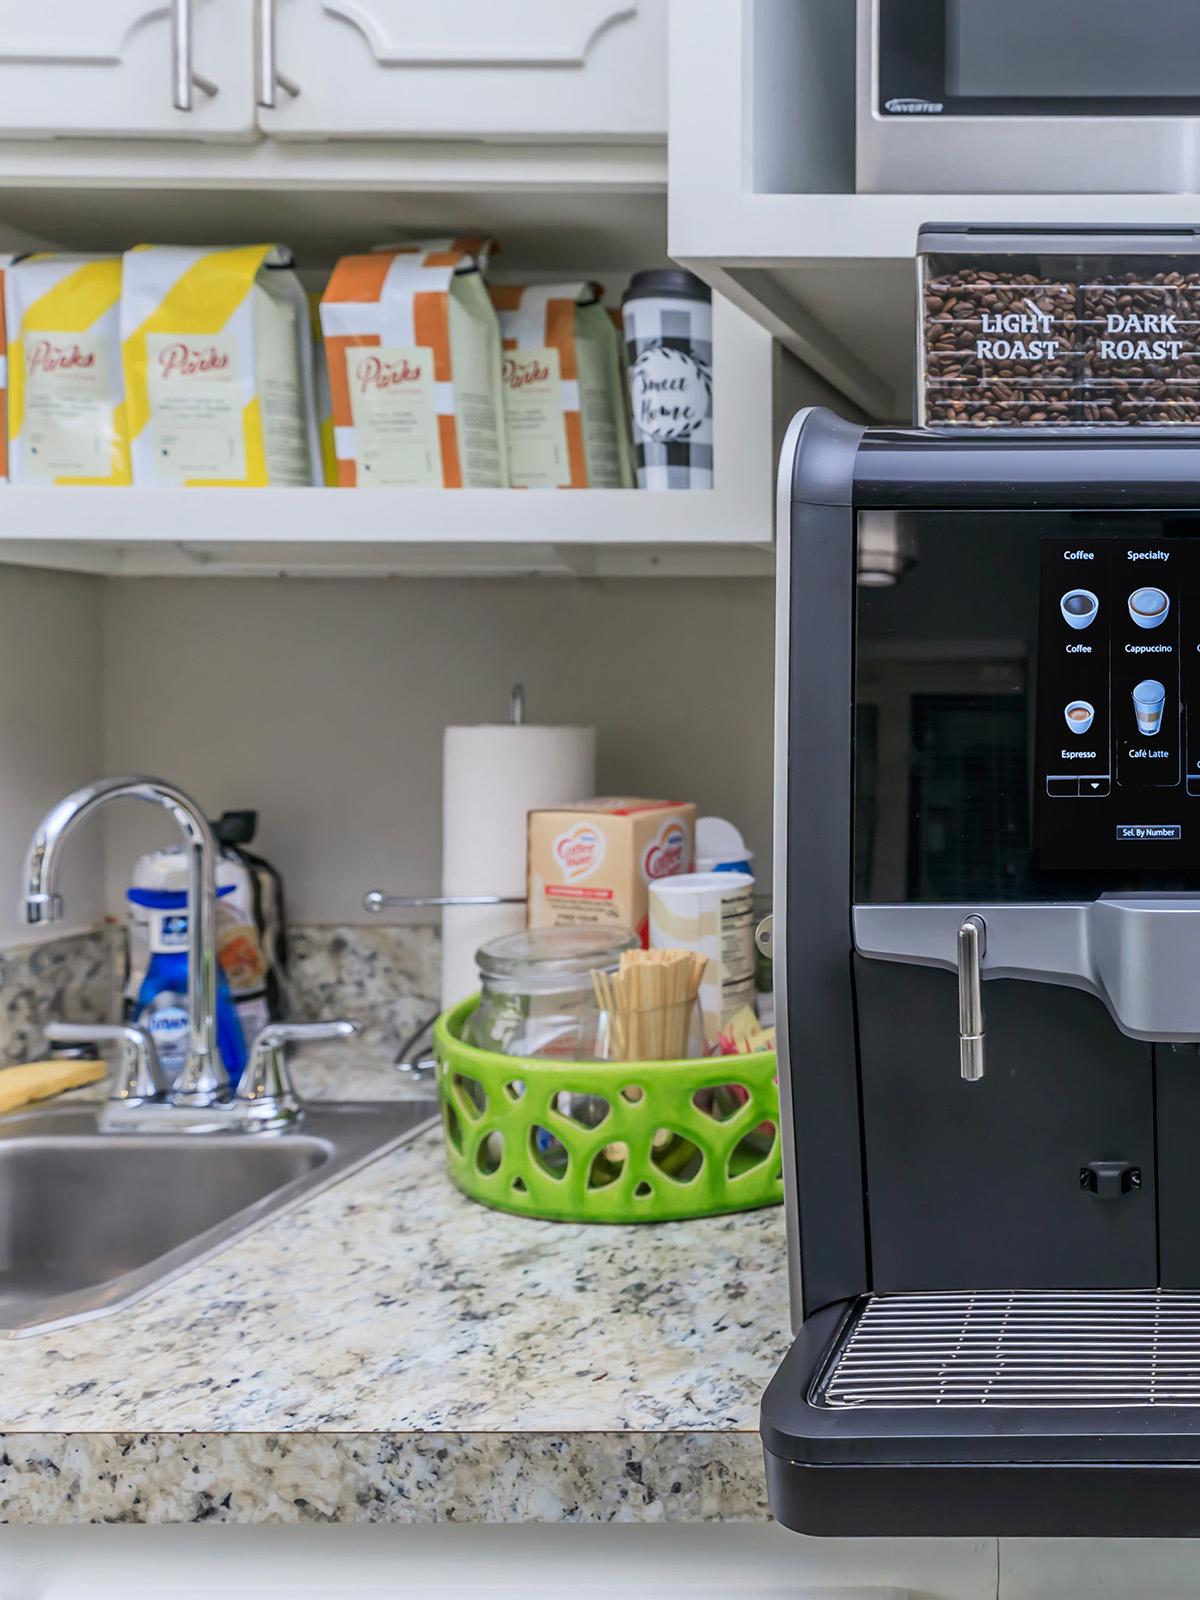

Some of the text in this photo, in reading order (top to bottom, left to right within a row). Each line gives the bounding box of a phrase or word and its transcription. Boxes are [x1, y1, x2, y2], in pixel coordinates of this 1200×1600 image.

[886, 99, 943, 113] INVERTER
[981, 314, 1054, 333] LIGHT
[1107, 314, 1177, 333] DARK
[976, 340, 1059, 360] ROAST
[1101, 340, 1183, 360] ROAST
[26, 341, 95, 377] Parks
[158, 343, 229, 377] Parks
[356, 356, 422, 393] Parks
[641, 399, 693, 422] Home
[1063, 550, 1095, 559] Coffee
[1127, 550, 1170, 561] Specialty
[1065, 644, 1093, 653] Coffee
[1124, 644, 1173, 654] Cappuccino
[1061, 749, 1097, 759] Espresso
[1128, 749, 1169, 758] Café Latte
[1122, 827, 1175, 838] Sel. By Number
